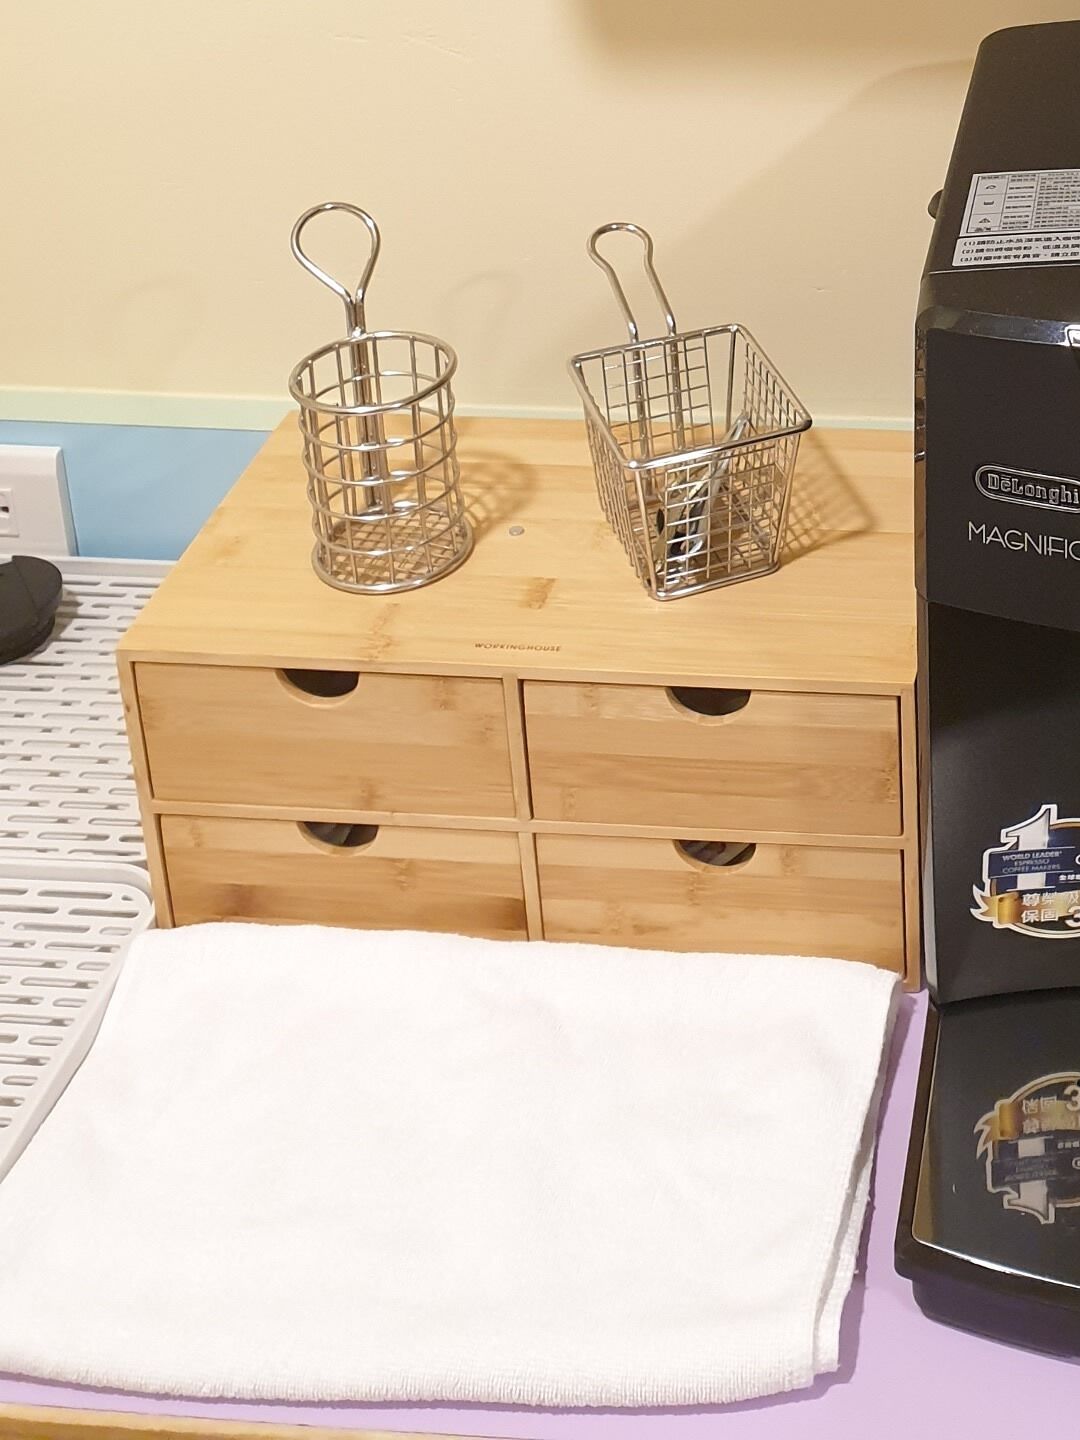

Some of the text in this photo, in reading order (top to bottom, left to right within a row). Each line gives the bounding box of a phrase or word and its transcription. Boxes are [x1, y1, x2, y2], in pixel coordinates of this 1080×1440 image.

[1002, 853, 1031, 862] WORLD
[1014, 859, 1050, 867] ESPRESSO
[1002, 863, 1061, 874] COFFEE MAKERS
